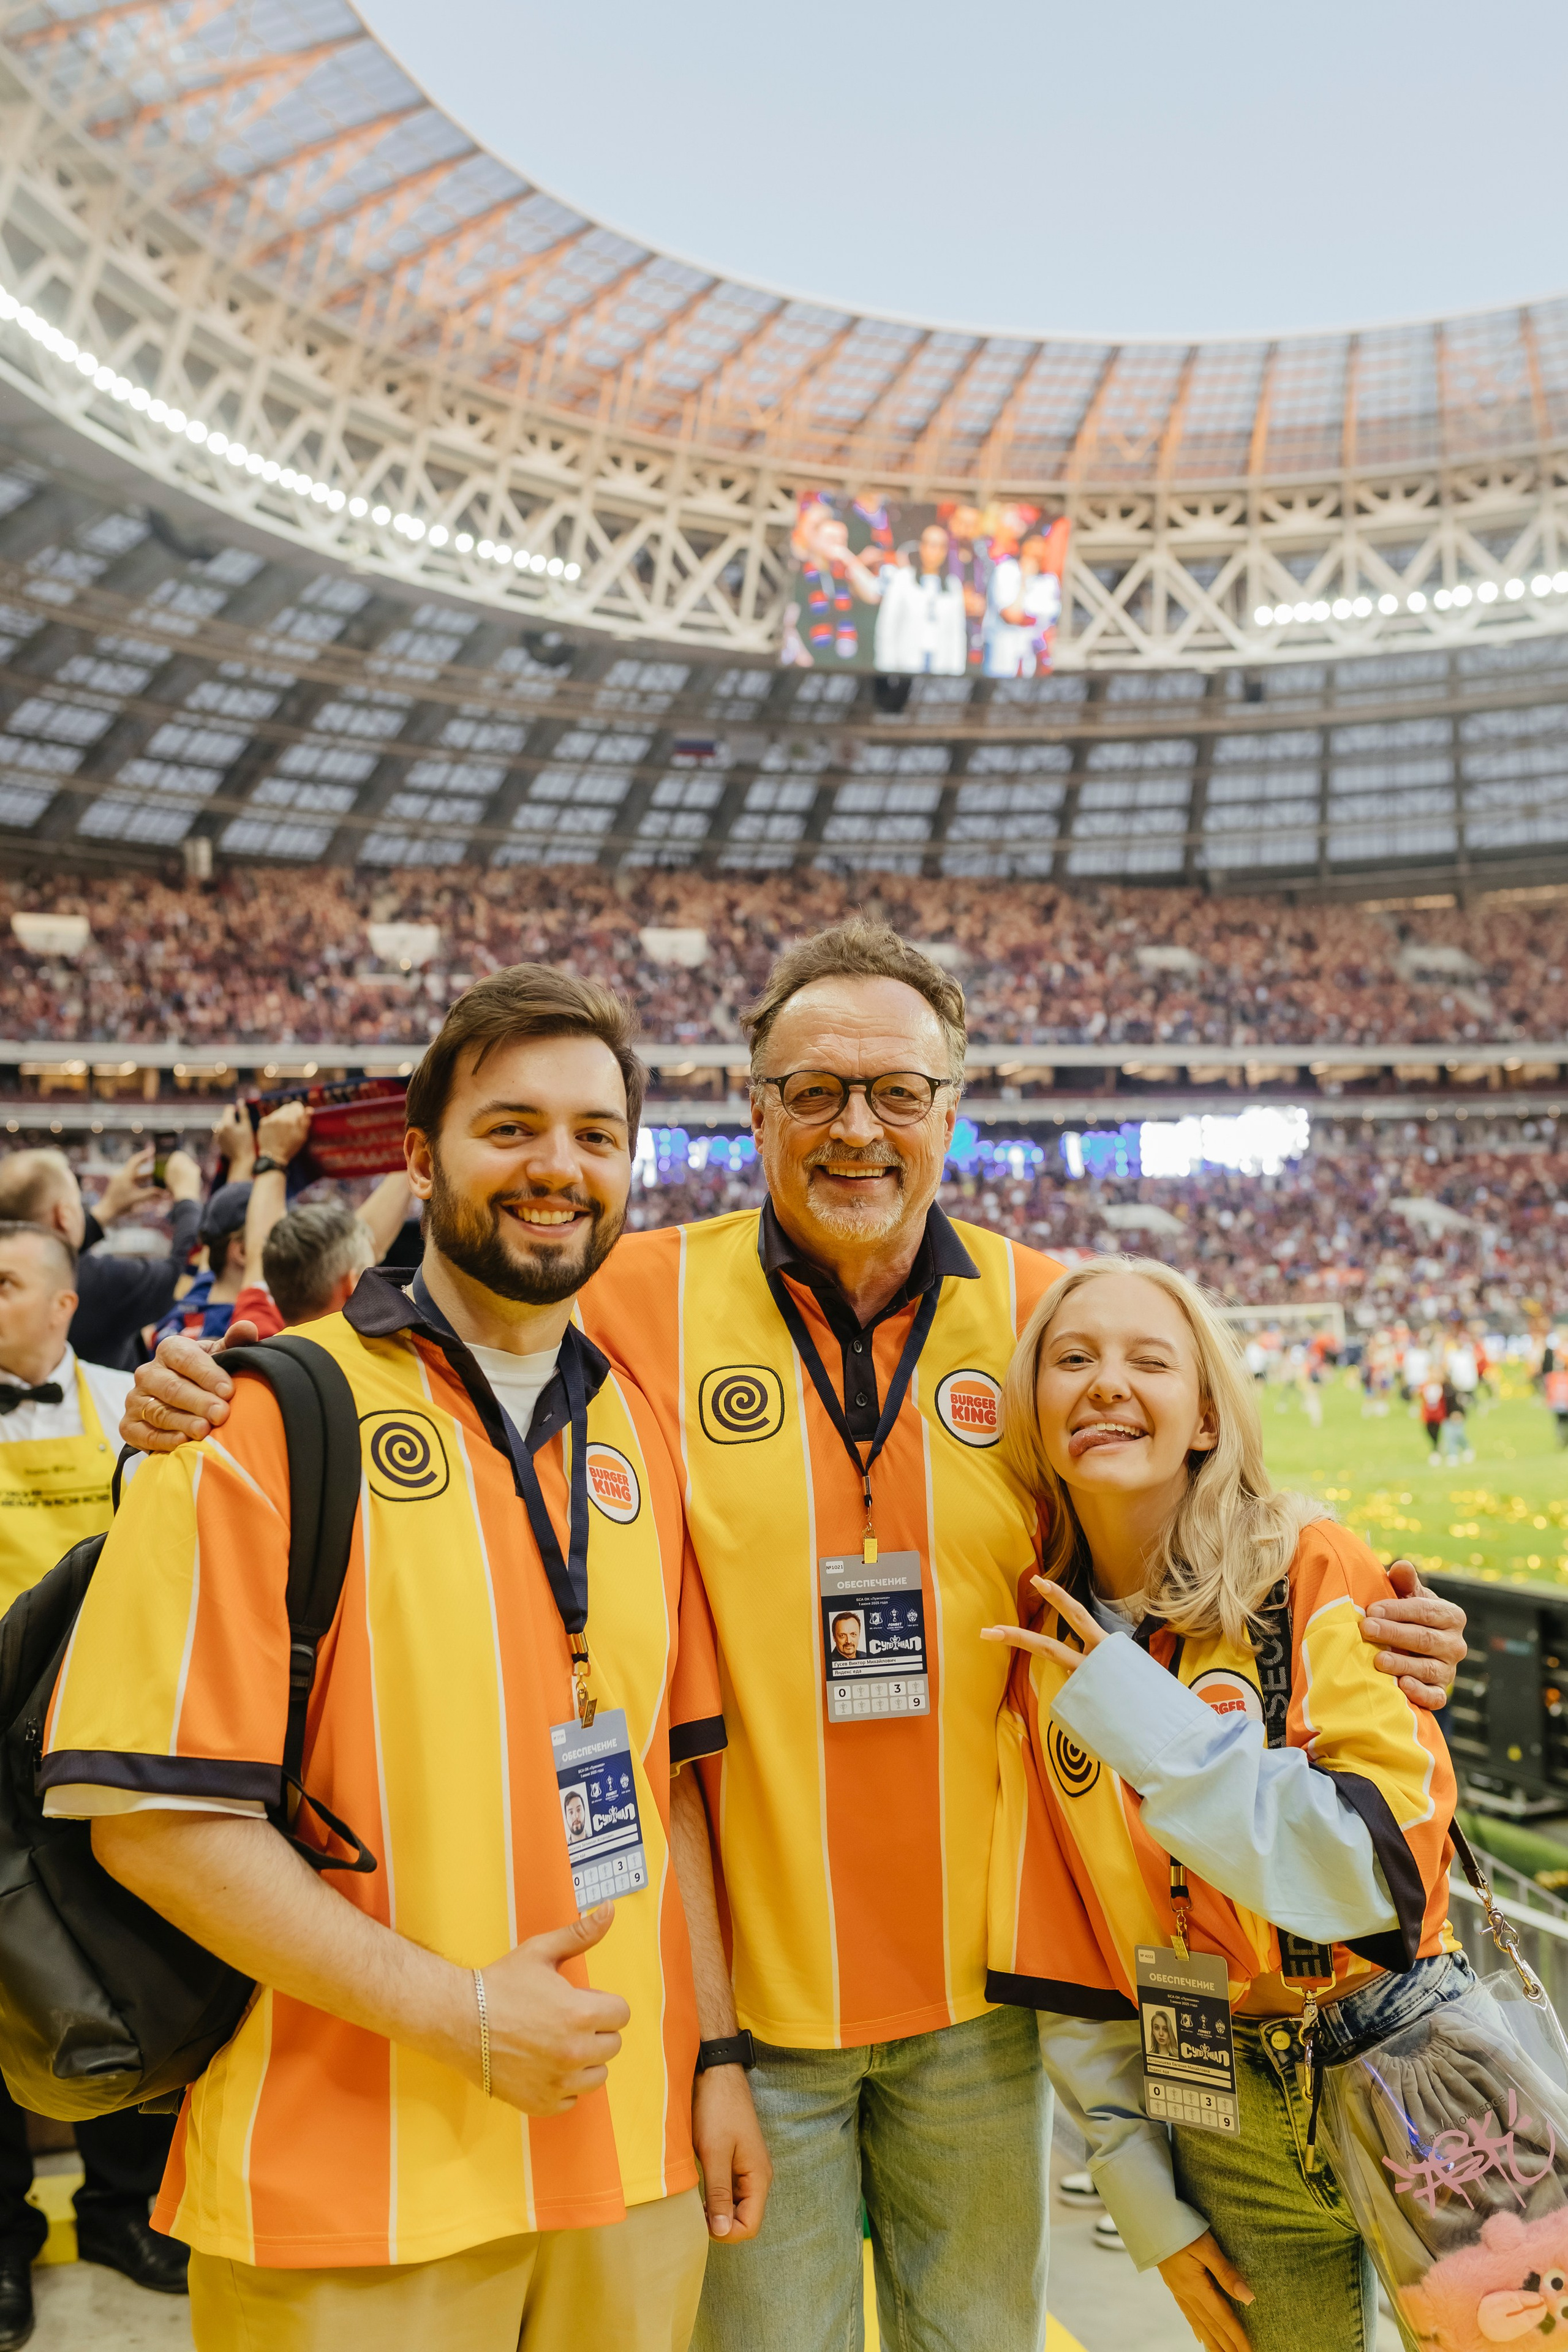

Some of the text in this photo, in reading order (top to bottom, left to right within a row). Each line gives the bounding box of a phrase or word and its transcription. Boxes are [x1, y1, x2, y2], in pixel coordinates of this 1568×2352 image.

[951, 1393, 996, 1411] BURGER
[951, 1404, 997, 1425] KING
[589, 1467, 629, 1487] BURGER
[592, 1478, 631, 1502] KING
[837, 1577, 907, 1589] ОБЕСПЕЧЕНИЕ
[839, 1684, 901, 1697] 0 3
[913, 1698, 921, 1706] 9
[1210, 1700, 1246, 1715] RGER
[562, 1738, 617, 1762] ОБЕСПЕЧЕНИЕ
[575, 1861, 623, 1886] 0 3
[635, 1872, 640, 1882] 9
[1149, 1973, 1215, 1991] ОБЕСПЕЧЕНИЕ
[1153, 2087, 1212, 2106] 0 3
[1224, 2117, 1231, 2127] 9
[1406, 2150, 1412, 2159] A
[1448, 2095, 1506, 2129] KNOWLEDGE
